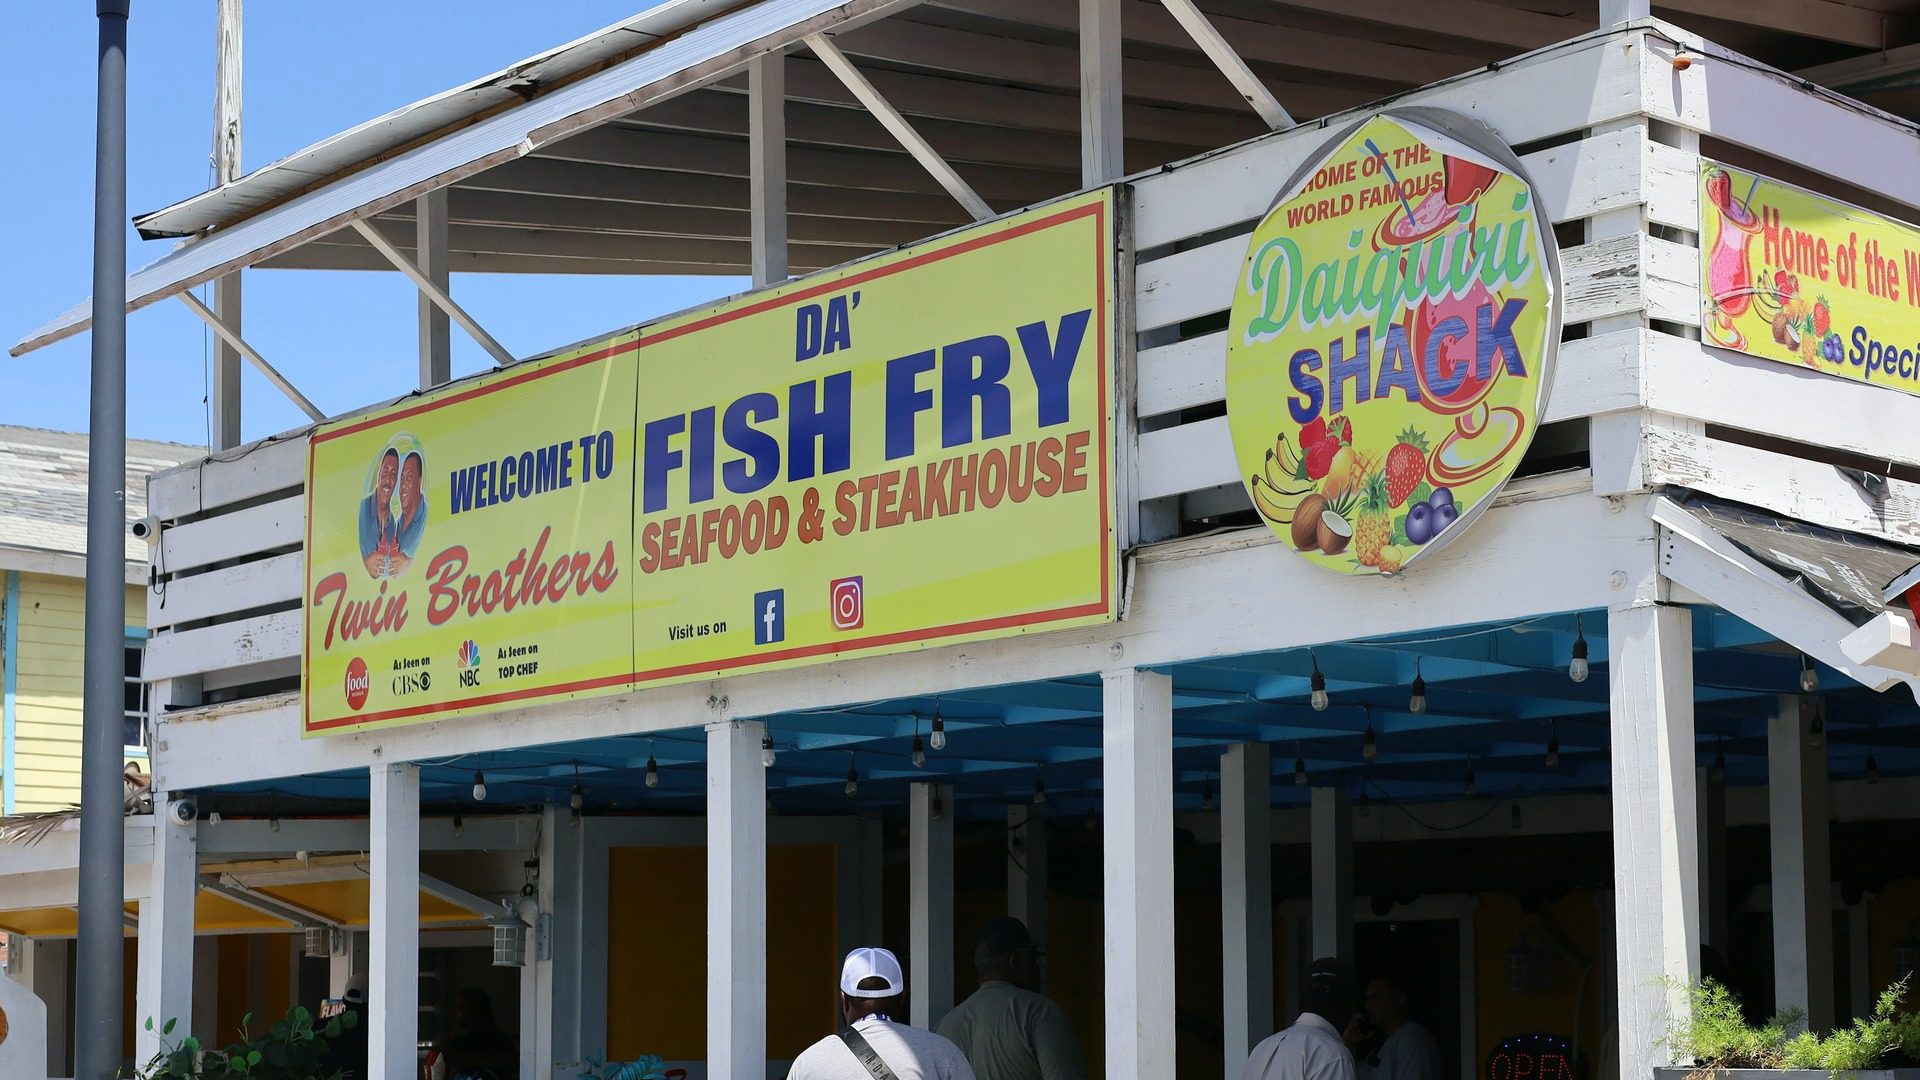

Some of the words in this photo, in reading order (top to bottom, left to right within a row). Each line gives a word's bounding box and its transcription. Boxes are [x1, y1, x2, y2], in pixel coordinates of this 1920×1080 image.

[1361, 152, 1389, 177] OF
[1393, 143, 1432, 170] THE
[1286, 193, 1354, 229] WORLD
[1359, 171, 1444, 211] FAMOUS
[1248, 192, 1530, 342] Daiquiri
[1763, 204, 1829, 283] Home
[1836, 232, 1858, 289] of
[1864, 239, 1900, 301] the
[1287, 298, 1528, 424] SHACK
[643, 370, 853, 515] FISH
[885, 308, 1092, 462] FRY
[450, 440, 573, 515] WELCOME
[579, 430, 614, 483] TO
[640, 495, 789, 574] SEAFOOD
[798, 487, 825, 543] &
[832, 430, 1090, 536] STEAKHOUSE
[314, 571, 408, 651] Twin
[426, 525, 618, 626] Brothers
[497, 647, 507, 660] As
[508, 645, 527, 658] Seen
[528, 644, 538, 655] on
[669, 624, 694, 641] Visit
[697, 623, 710, 636] us
[713, 621, 727, 634] on
[346, 669, 368, 700] food
[392, 673, 420, 697] CBS
[393, 659, 402, 671] As
[403, 657, 420, 670] Seen
[421, 657, 430, 666] on
[459, 668, 480, 688] NBC
[498, 665, 515, 679] TOP
[516, 661, 538, 676] CHEF
